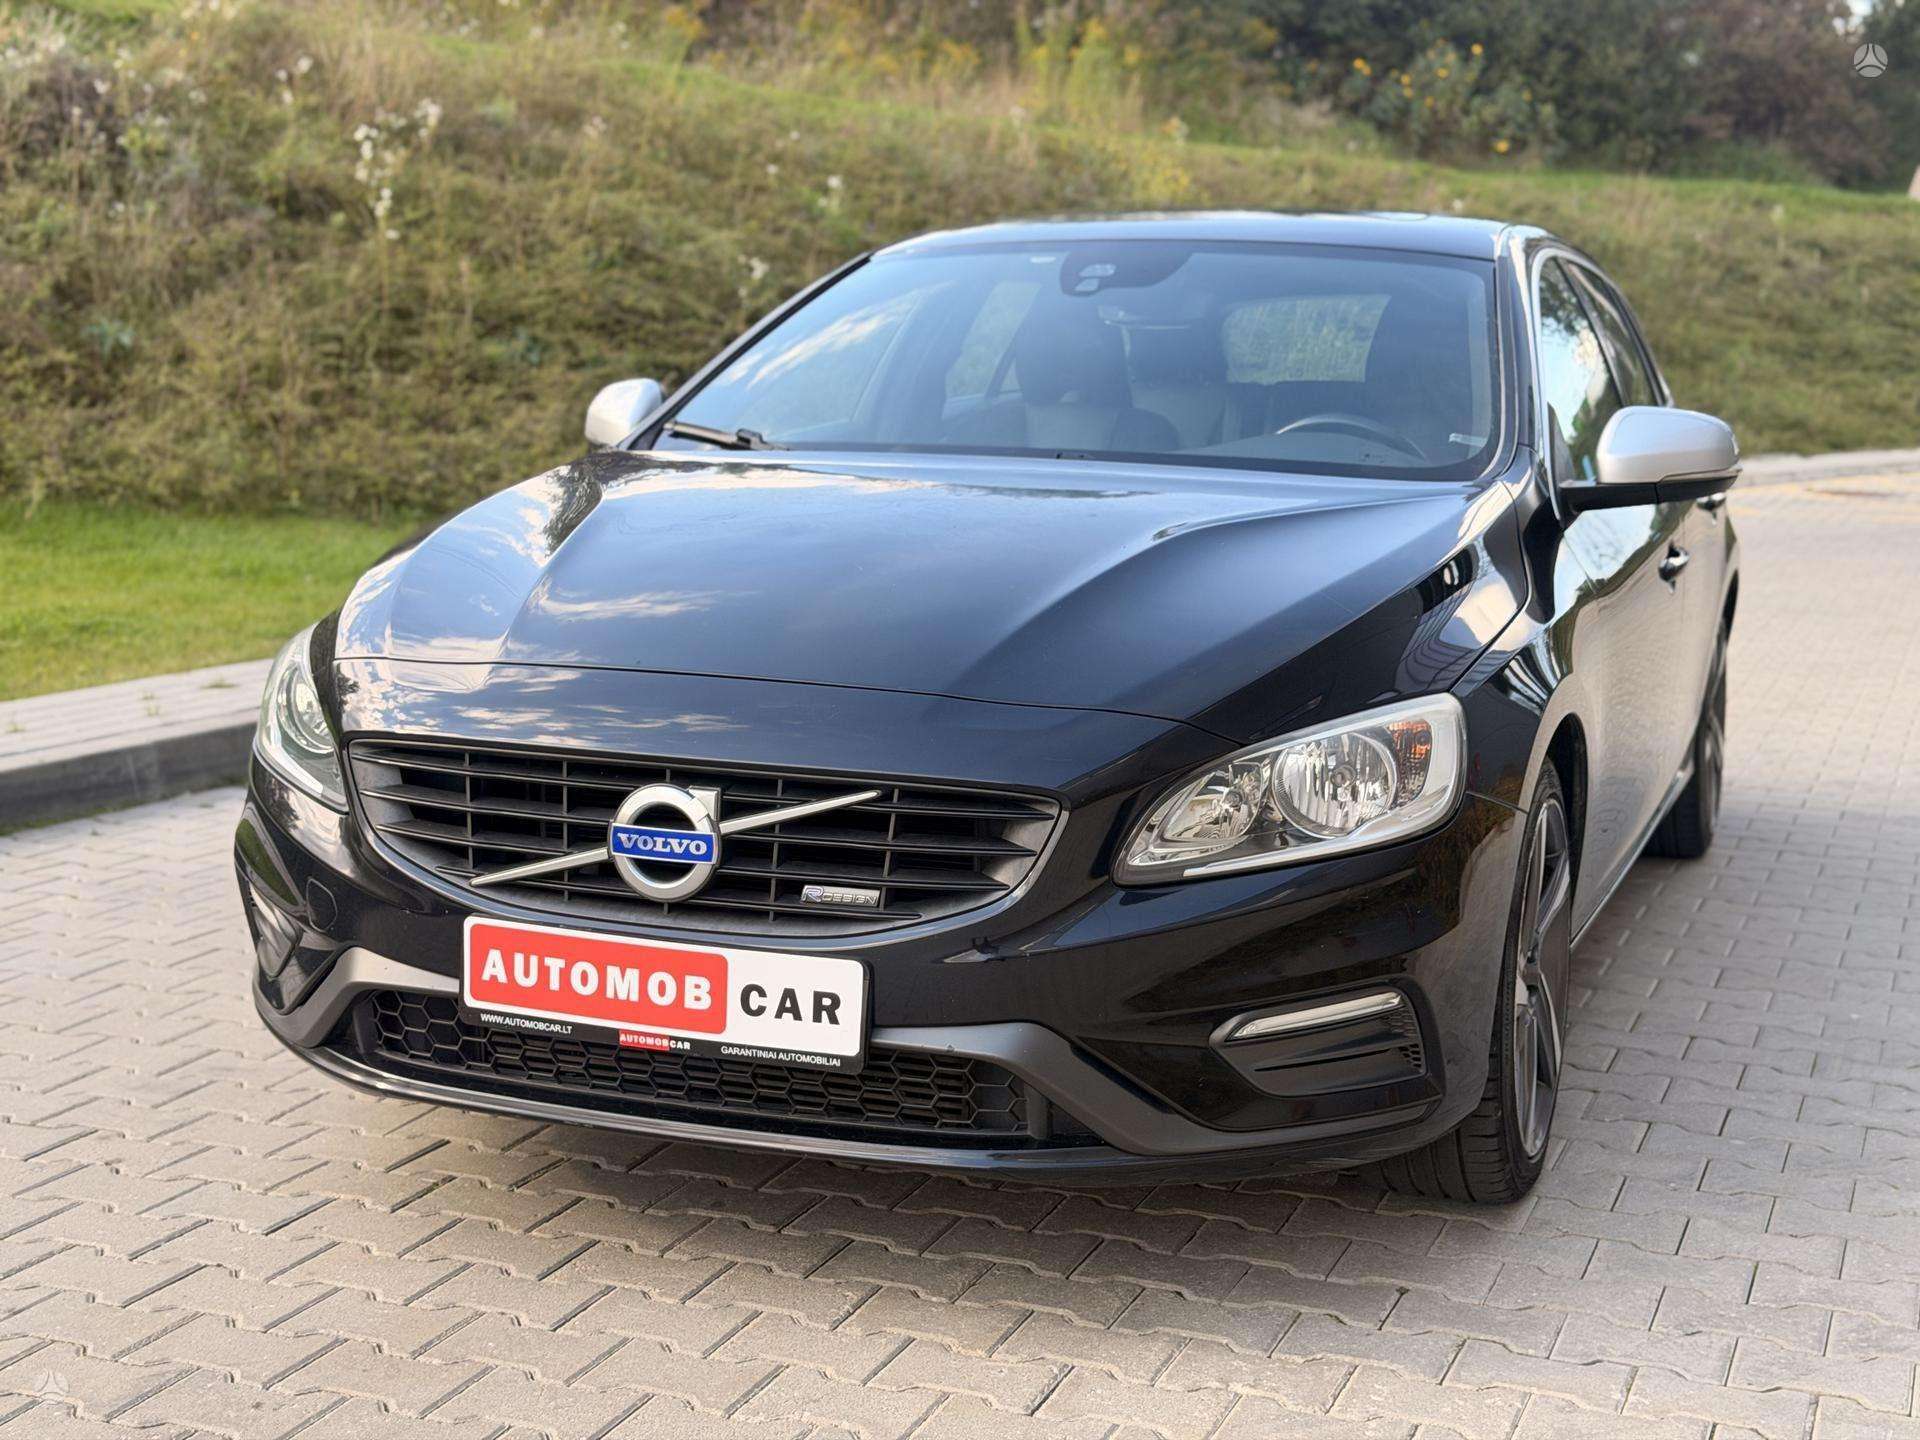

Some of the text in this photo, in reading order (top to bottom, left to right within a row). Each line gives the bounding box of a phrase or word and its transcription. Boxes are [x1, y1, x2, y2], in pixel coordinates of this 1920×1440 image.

[617, 832, 708, 856] VOLVO
[481, 949, 842, 1026] AUTOMOB CAR
[480, 1013, 573, 1035] WWW.AUTOMOBCAR.LT
[720, 1045, 841, 1067] GARANTINIAI AUTOMOBILIAI
